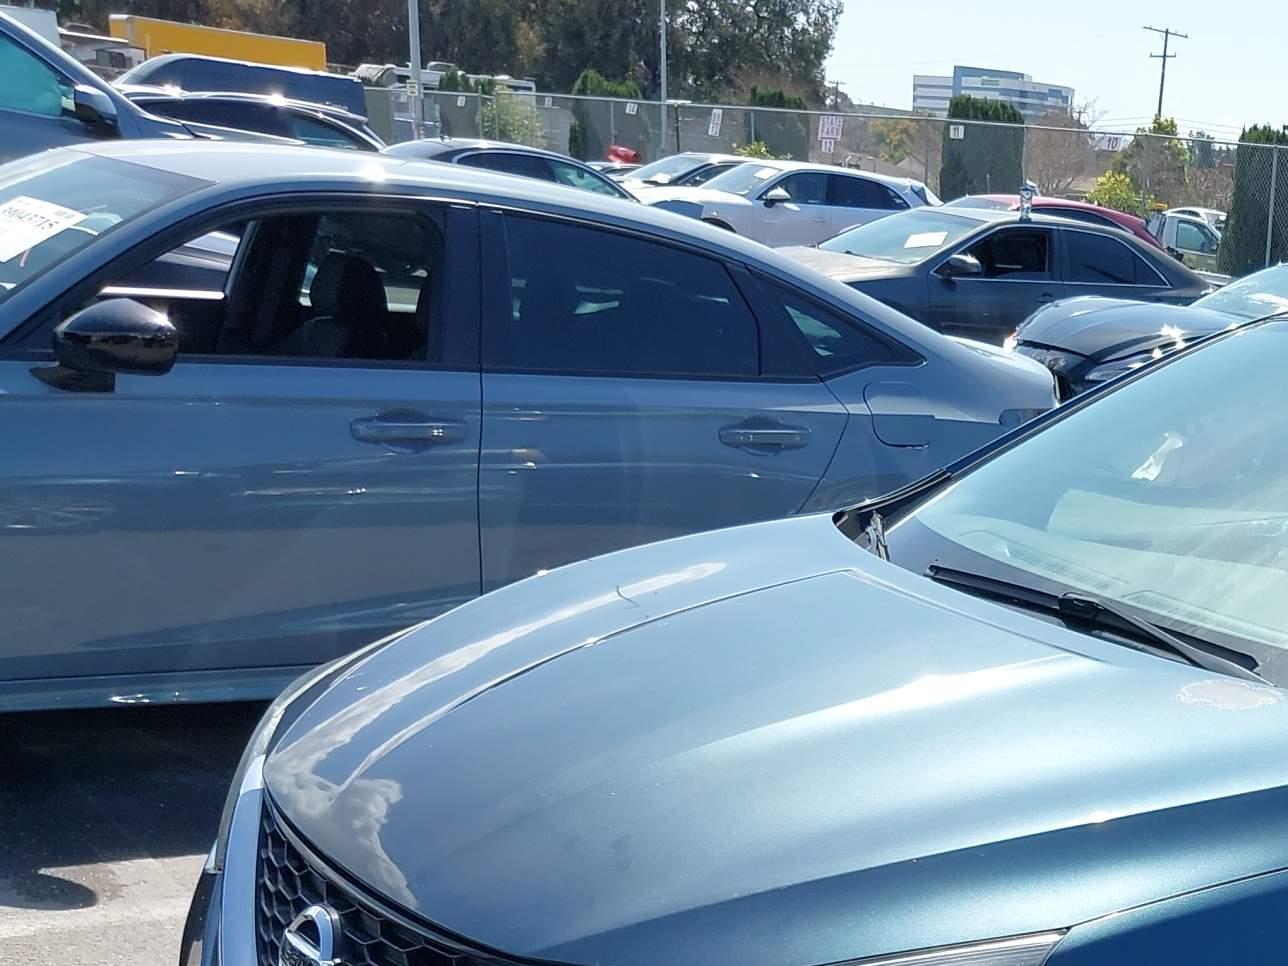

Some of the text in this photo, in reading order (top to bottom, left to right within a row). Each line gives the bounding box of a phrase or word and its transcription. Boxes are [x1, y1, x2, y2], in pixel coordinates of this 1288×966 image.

[952, 127, 961, 137] 11
[824, 140, 834, 152] 12
[1106, 137, 1118, 149] 10
